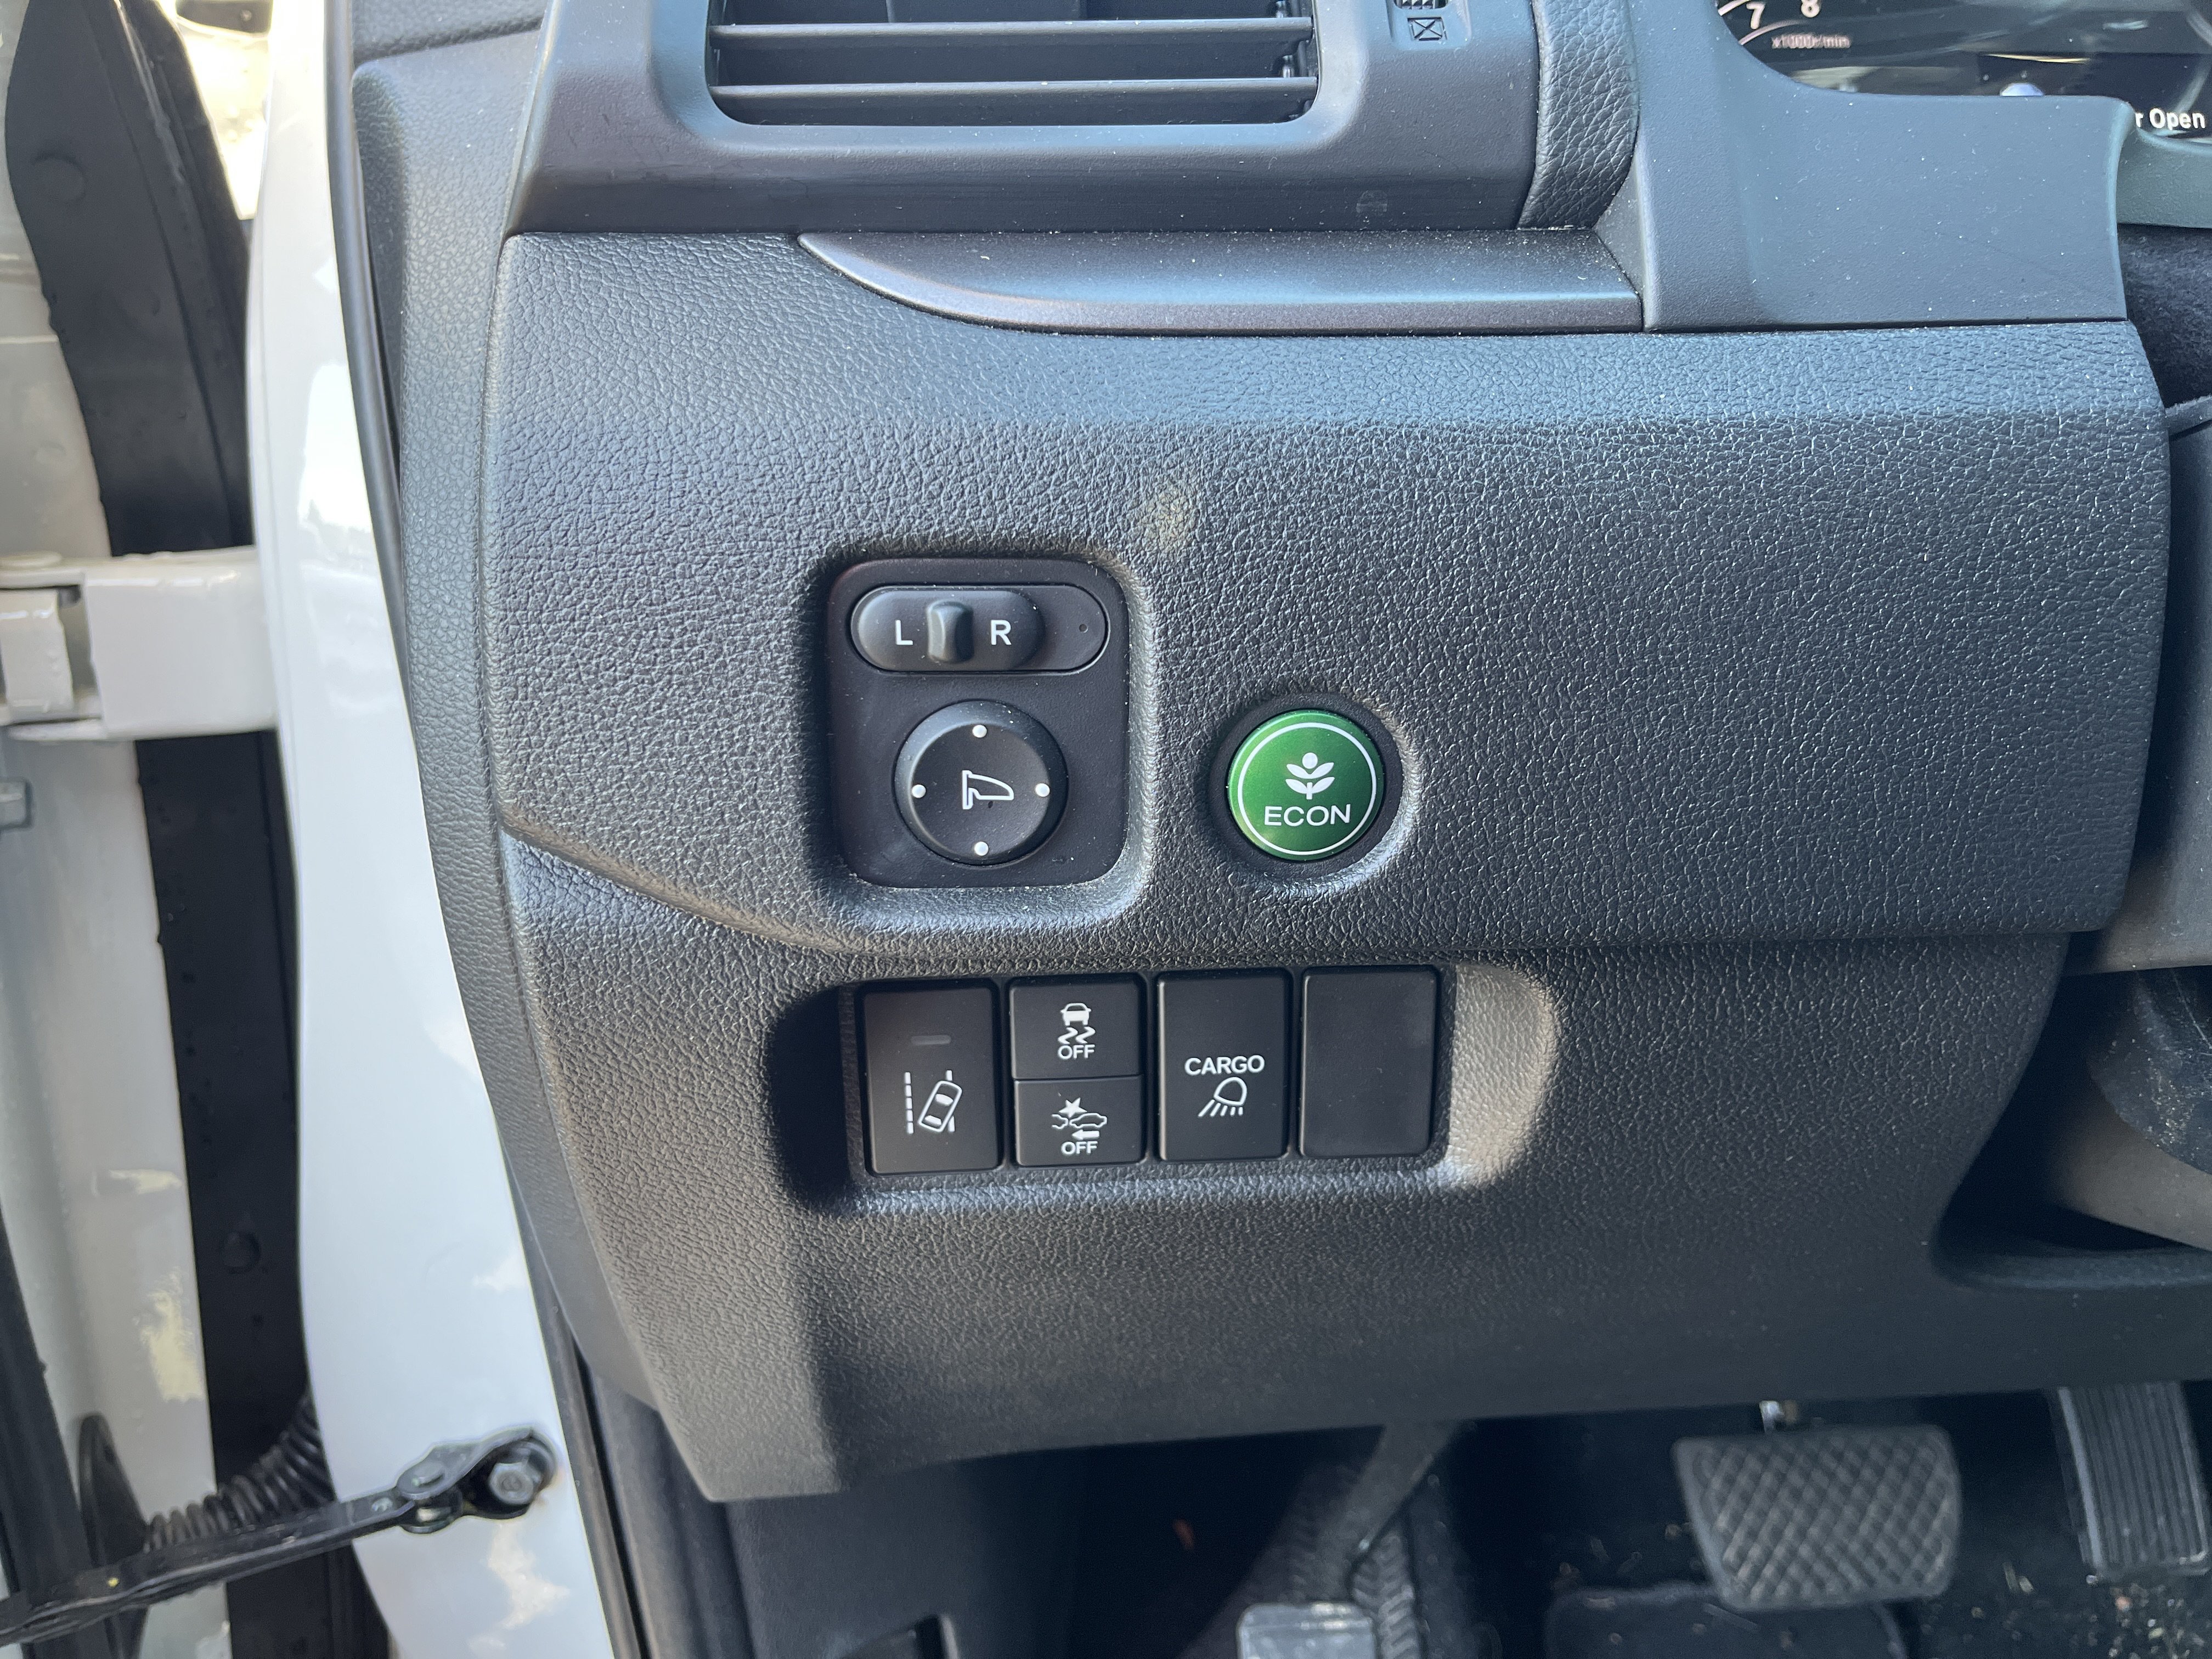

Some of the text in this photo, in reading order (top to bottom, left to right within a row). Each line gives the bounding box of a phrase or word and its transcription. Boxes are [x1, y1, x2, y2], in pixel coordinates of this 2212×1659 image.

[1746, 2, 1766, 30] 7
[1801, 0, 1820, 18] 8
[2149, 108, 2206, 131] Open
[895, 619, 913, 645] L
[990, 619, 1012, 645] R
[1264, 804, 1351, 827] ECON
[1058, 1045, 1095, 1060] OFF
[1184, 1054, 1265, 1075] CARGO
[1061, 1141, 1098, 1155] OFF
